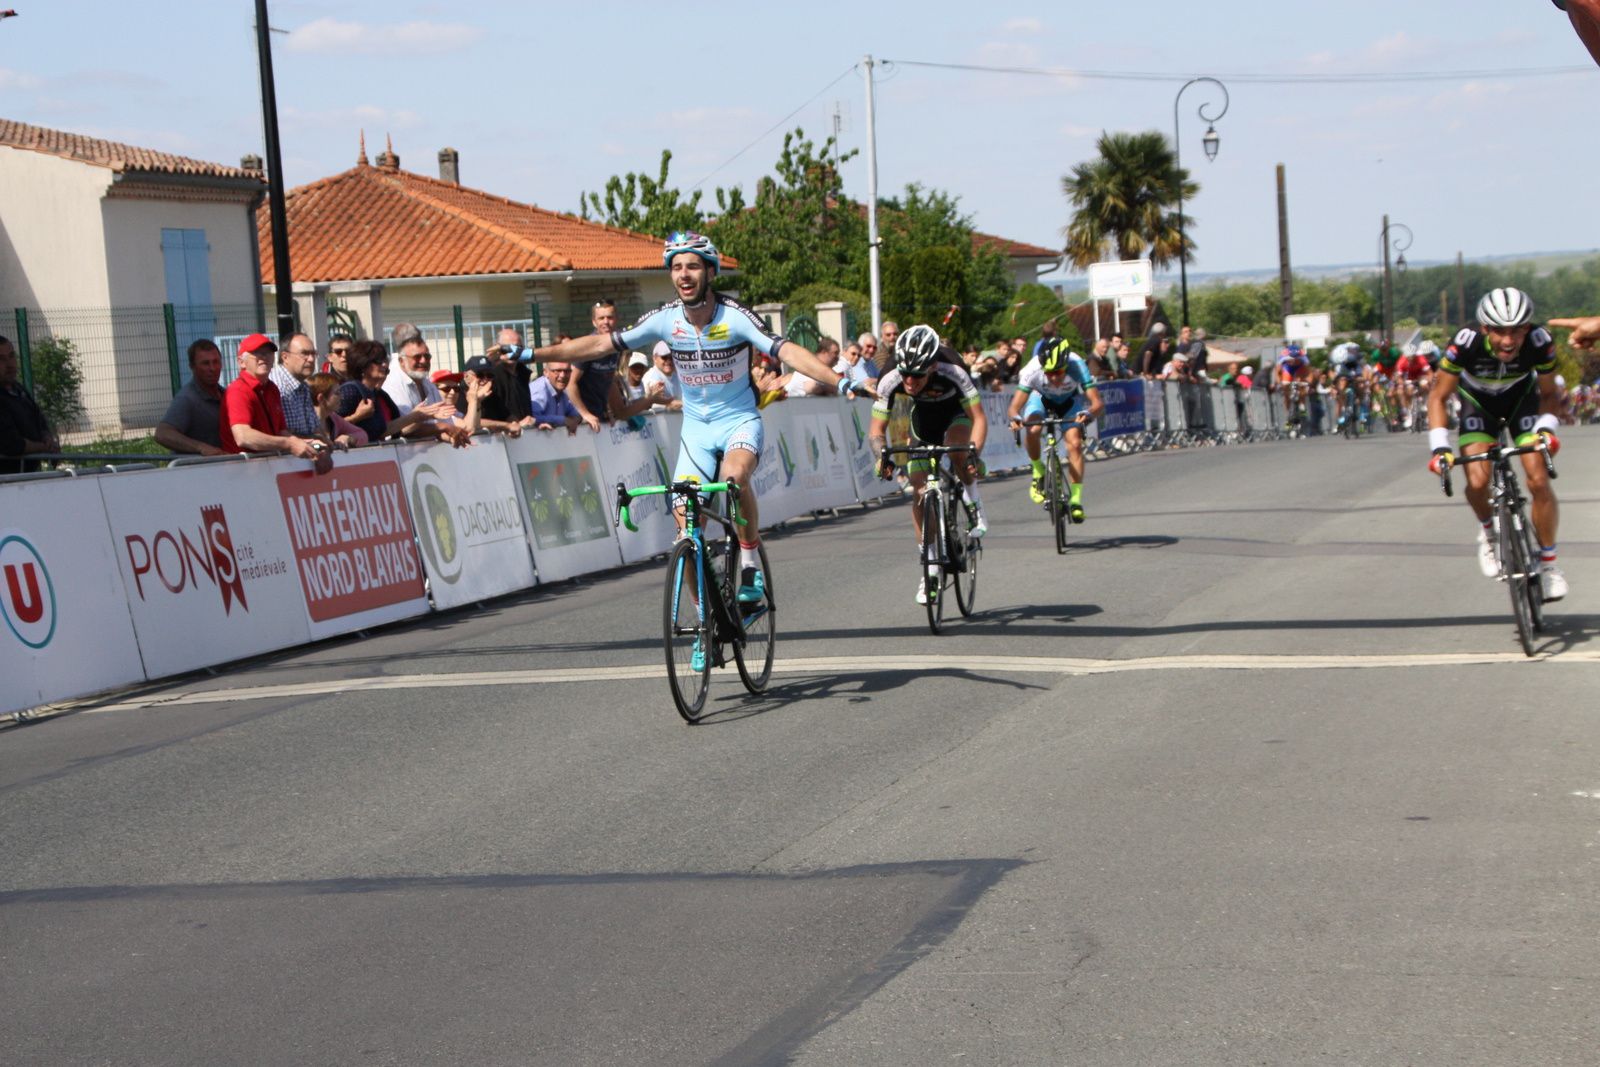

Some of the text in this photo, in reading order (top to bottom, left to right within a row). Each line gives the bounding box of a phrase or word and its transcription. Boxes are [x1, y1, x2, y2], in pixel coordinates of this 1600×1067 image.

[702, 357, 737, 370] Morin
[286, 479, 407, 550] MATÉRIAUX
[457, 495, 520, 537] DAGNAUD
[124, 519, 237, 602] PONS
[236, 542, 255, 560] cité
[241, 558, 287, 581] médiévale
[301, 539, 417, 601] NORD BLAYAIS
[3, 562, 44, 624] U
